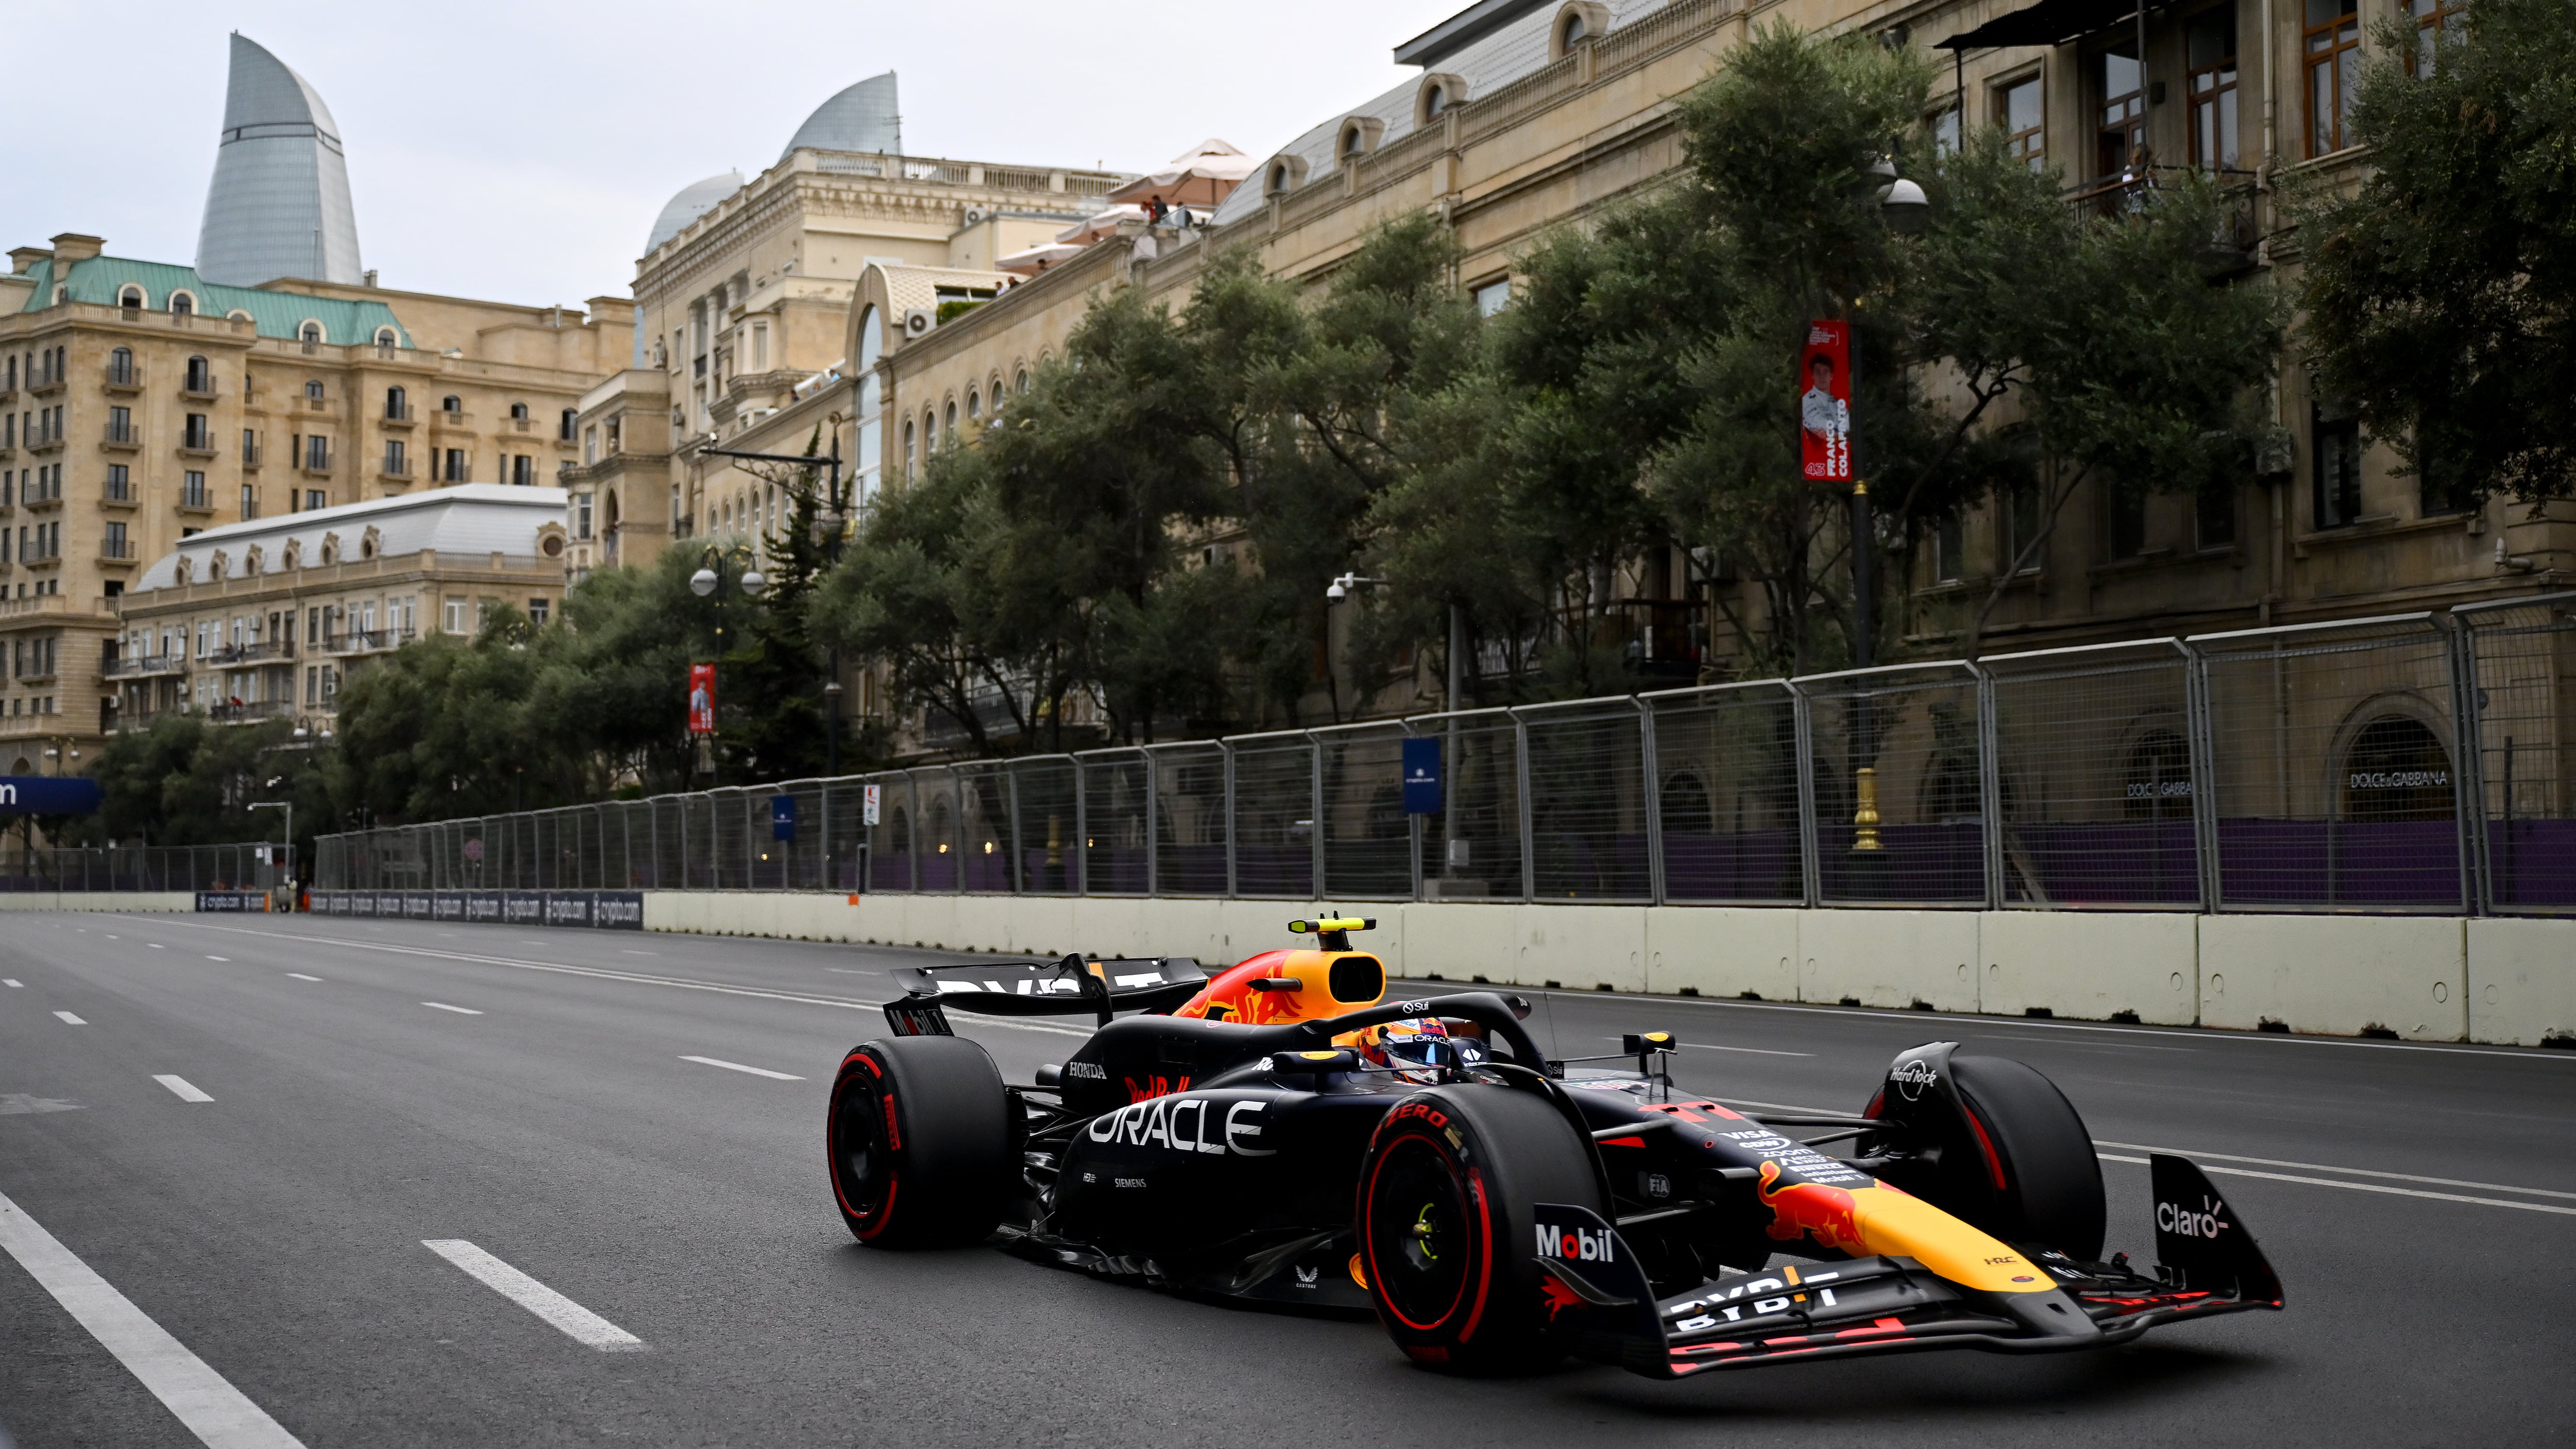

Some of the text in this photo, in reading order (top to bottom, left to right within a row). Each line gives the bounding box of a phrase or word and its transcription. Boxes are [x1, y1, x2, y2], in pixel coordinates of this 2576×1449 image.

[1837, 398, 1848, 477] COLAPINTO
[1826, 420, 1836, 477] FRANCO
[1805, 463, 1825, 476] 43
[1415, 1002, 1429, 1011] Sui
[889, 1009, 936, 1035] Mobil
[1069, 1062, 1107, 1080] HONDA
[1890, 1067, 1916, 1082] Hard
[1384, 1103, 1448, 1128] ZERO
[1089, 1099, 1277, 1156] ORACLE
[1717, 1130, 1778, 1140] VISA
[1738, 1138, 1781, 1149] CDW
[1757, 1148, 1816, 1158] zoom
[1115, 1178, 1147, 1187] SIEMENS
[1649, 1178, 1670, 1193] FIA
[1811, 1175, 1856, 1183] Mobil
[2157, 1202, 2218, 1239] Claro
[1535, 1228, 1614, 1262] Mobil
[1984, 1256, 2017, 1265] HRC
